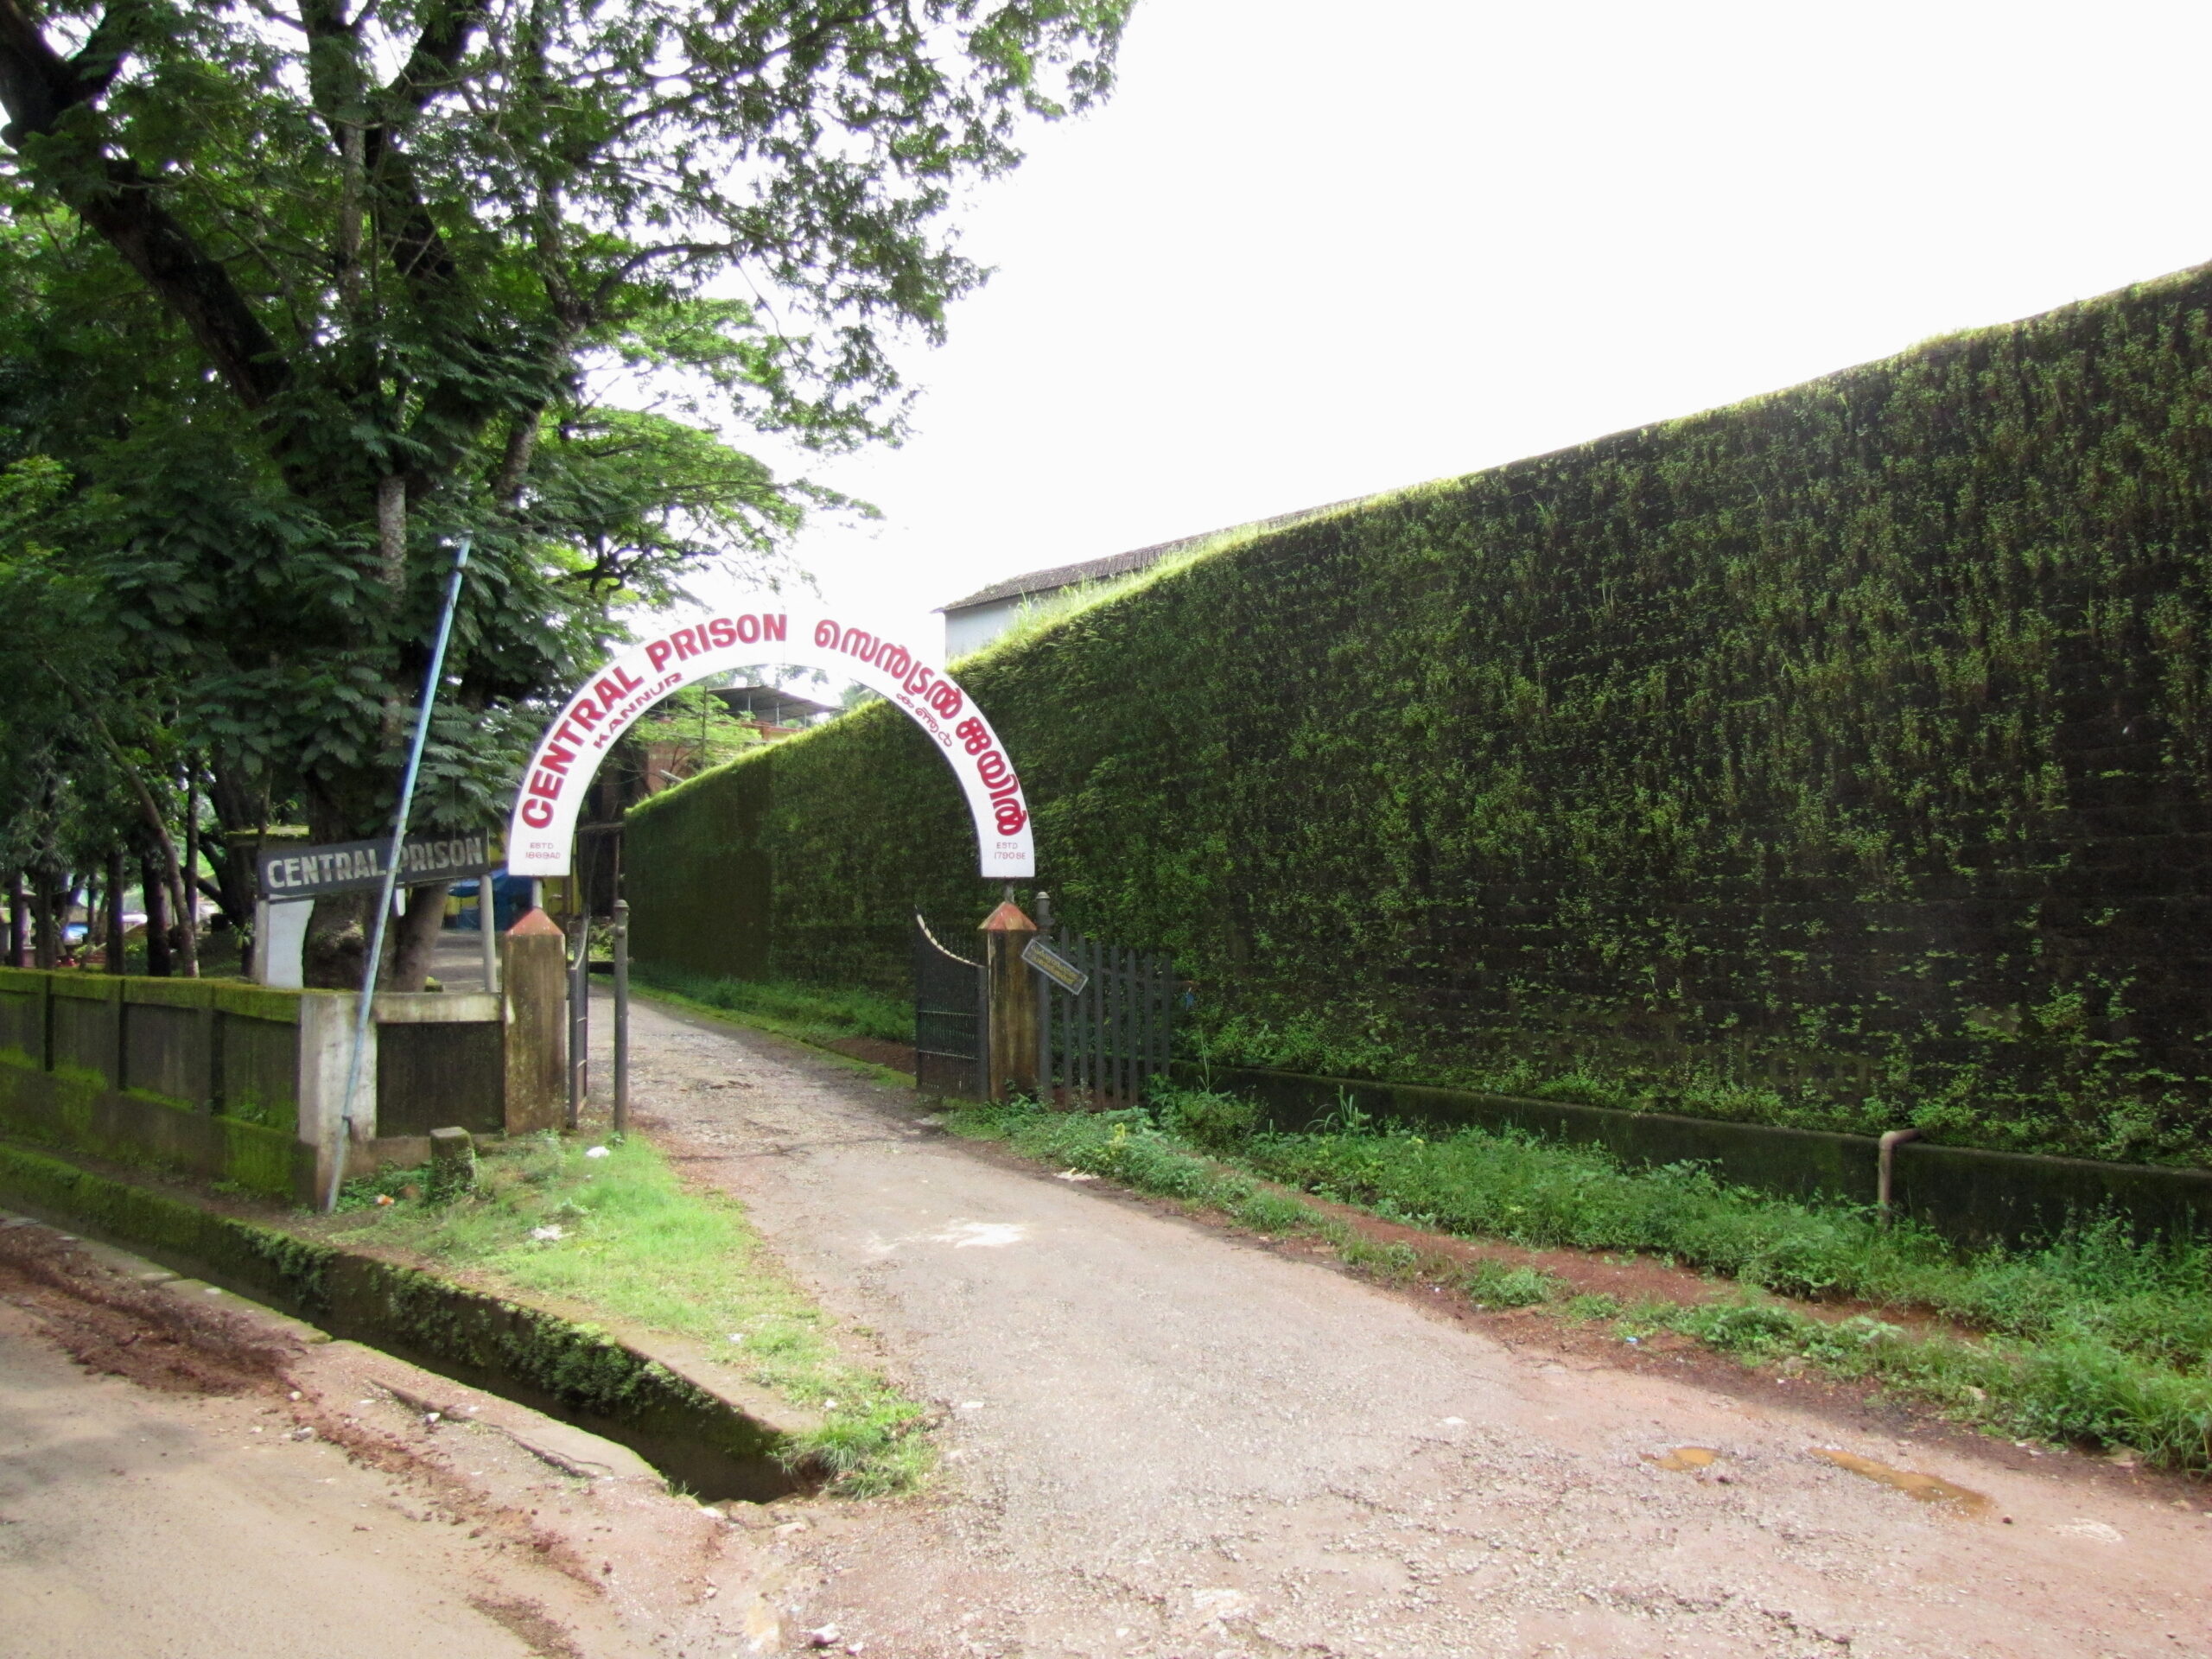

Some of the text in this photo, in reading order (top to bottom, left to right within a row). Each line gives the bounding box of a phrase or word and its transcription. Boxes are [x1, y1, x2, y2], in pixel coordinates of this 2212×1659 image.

[522, 613, 787, 829] CENTRAL PRISON
[593, 672, 683, 750] KANNUR
[956, 716, 1027, 836] ജയിൽ
[268, 849, 387, 888] CENTRAL
